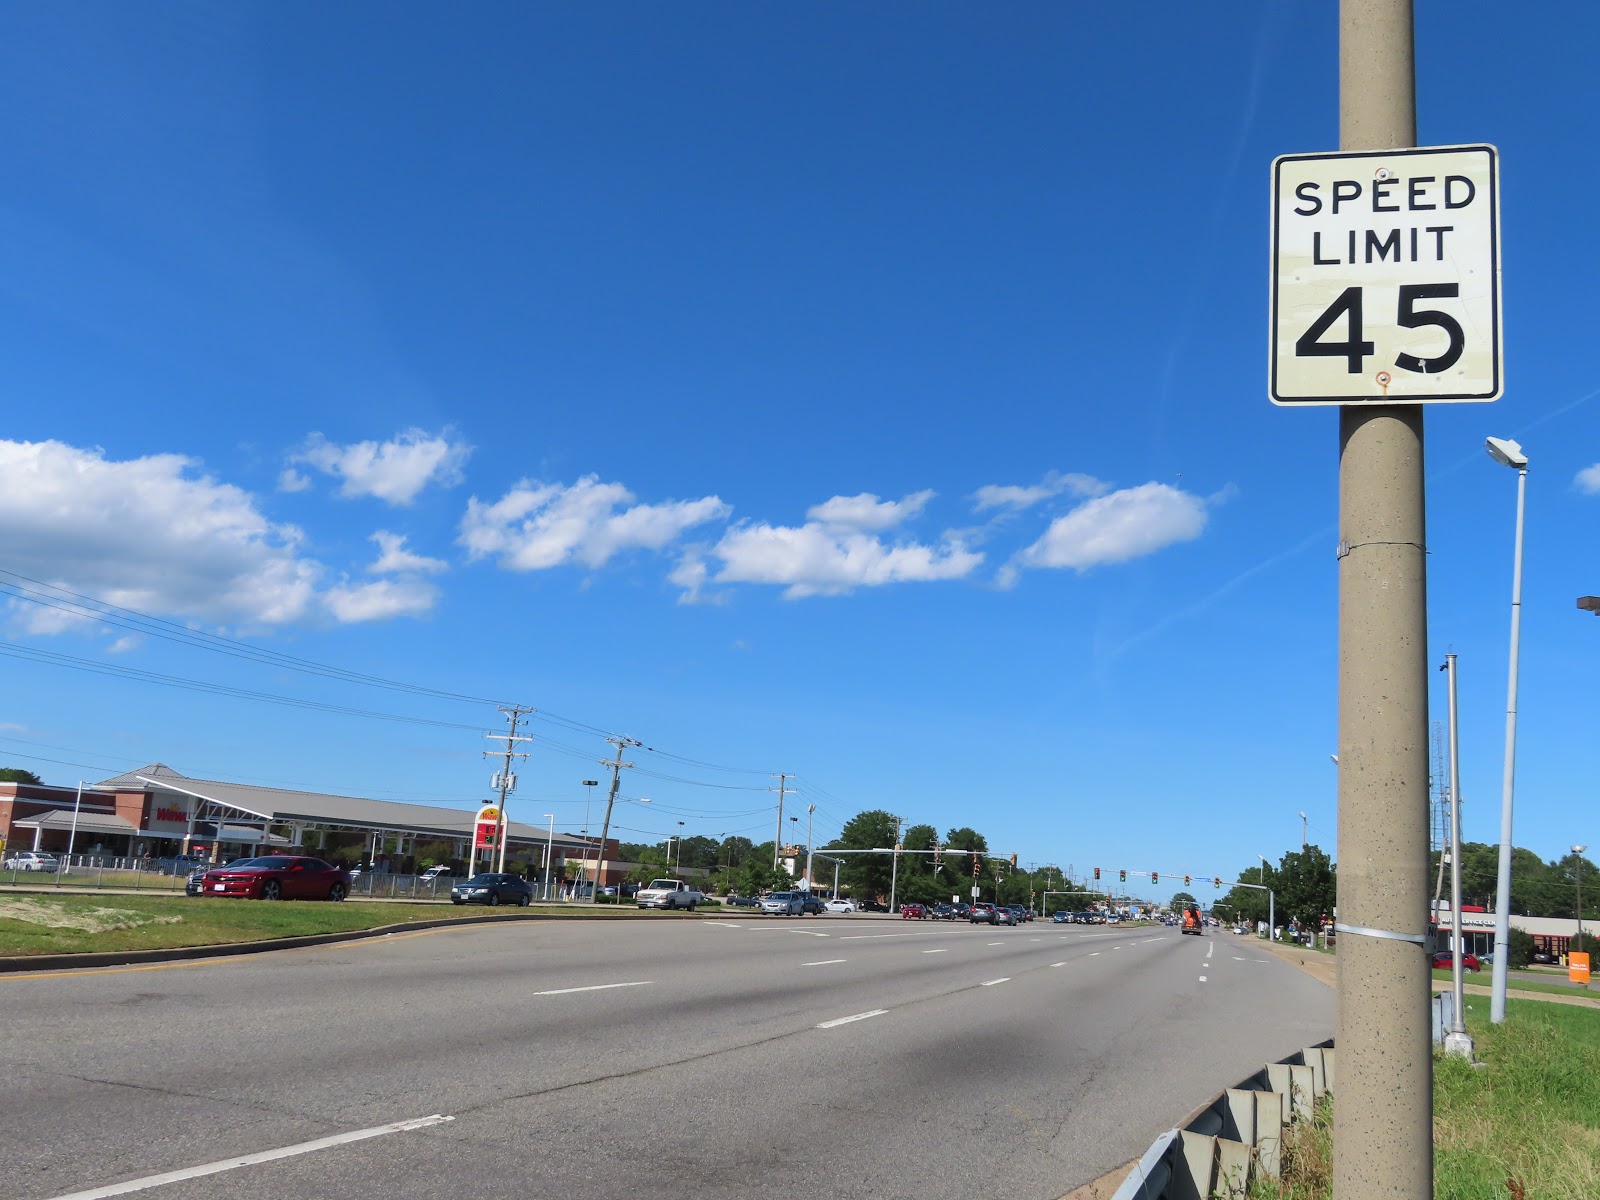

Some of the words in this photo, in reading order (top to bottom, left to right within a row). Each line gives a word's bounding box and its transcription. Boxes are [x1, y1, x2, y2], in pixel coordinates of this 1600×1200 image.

[1293, 175, 1476, 217] SPEED
[1313, 226, 1454, 266] LIMIT
[1295, 282, 1465, 374] 45
[156, 807, 187, 822] Waw
[482, 812, 499, 820] Waw
